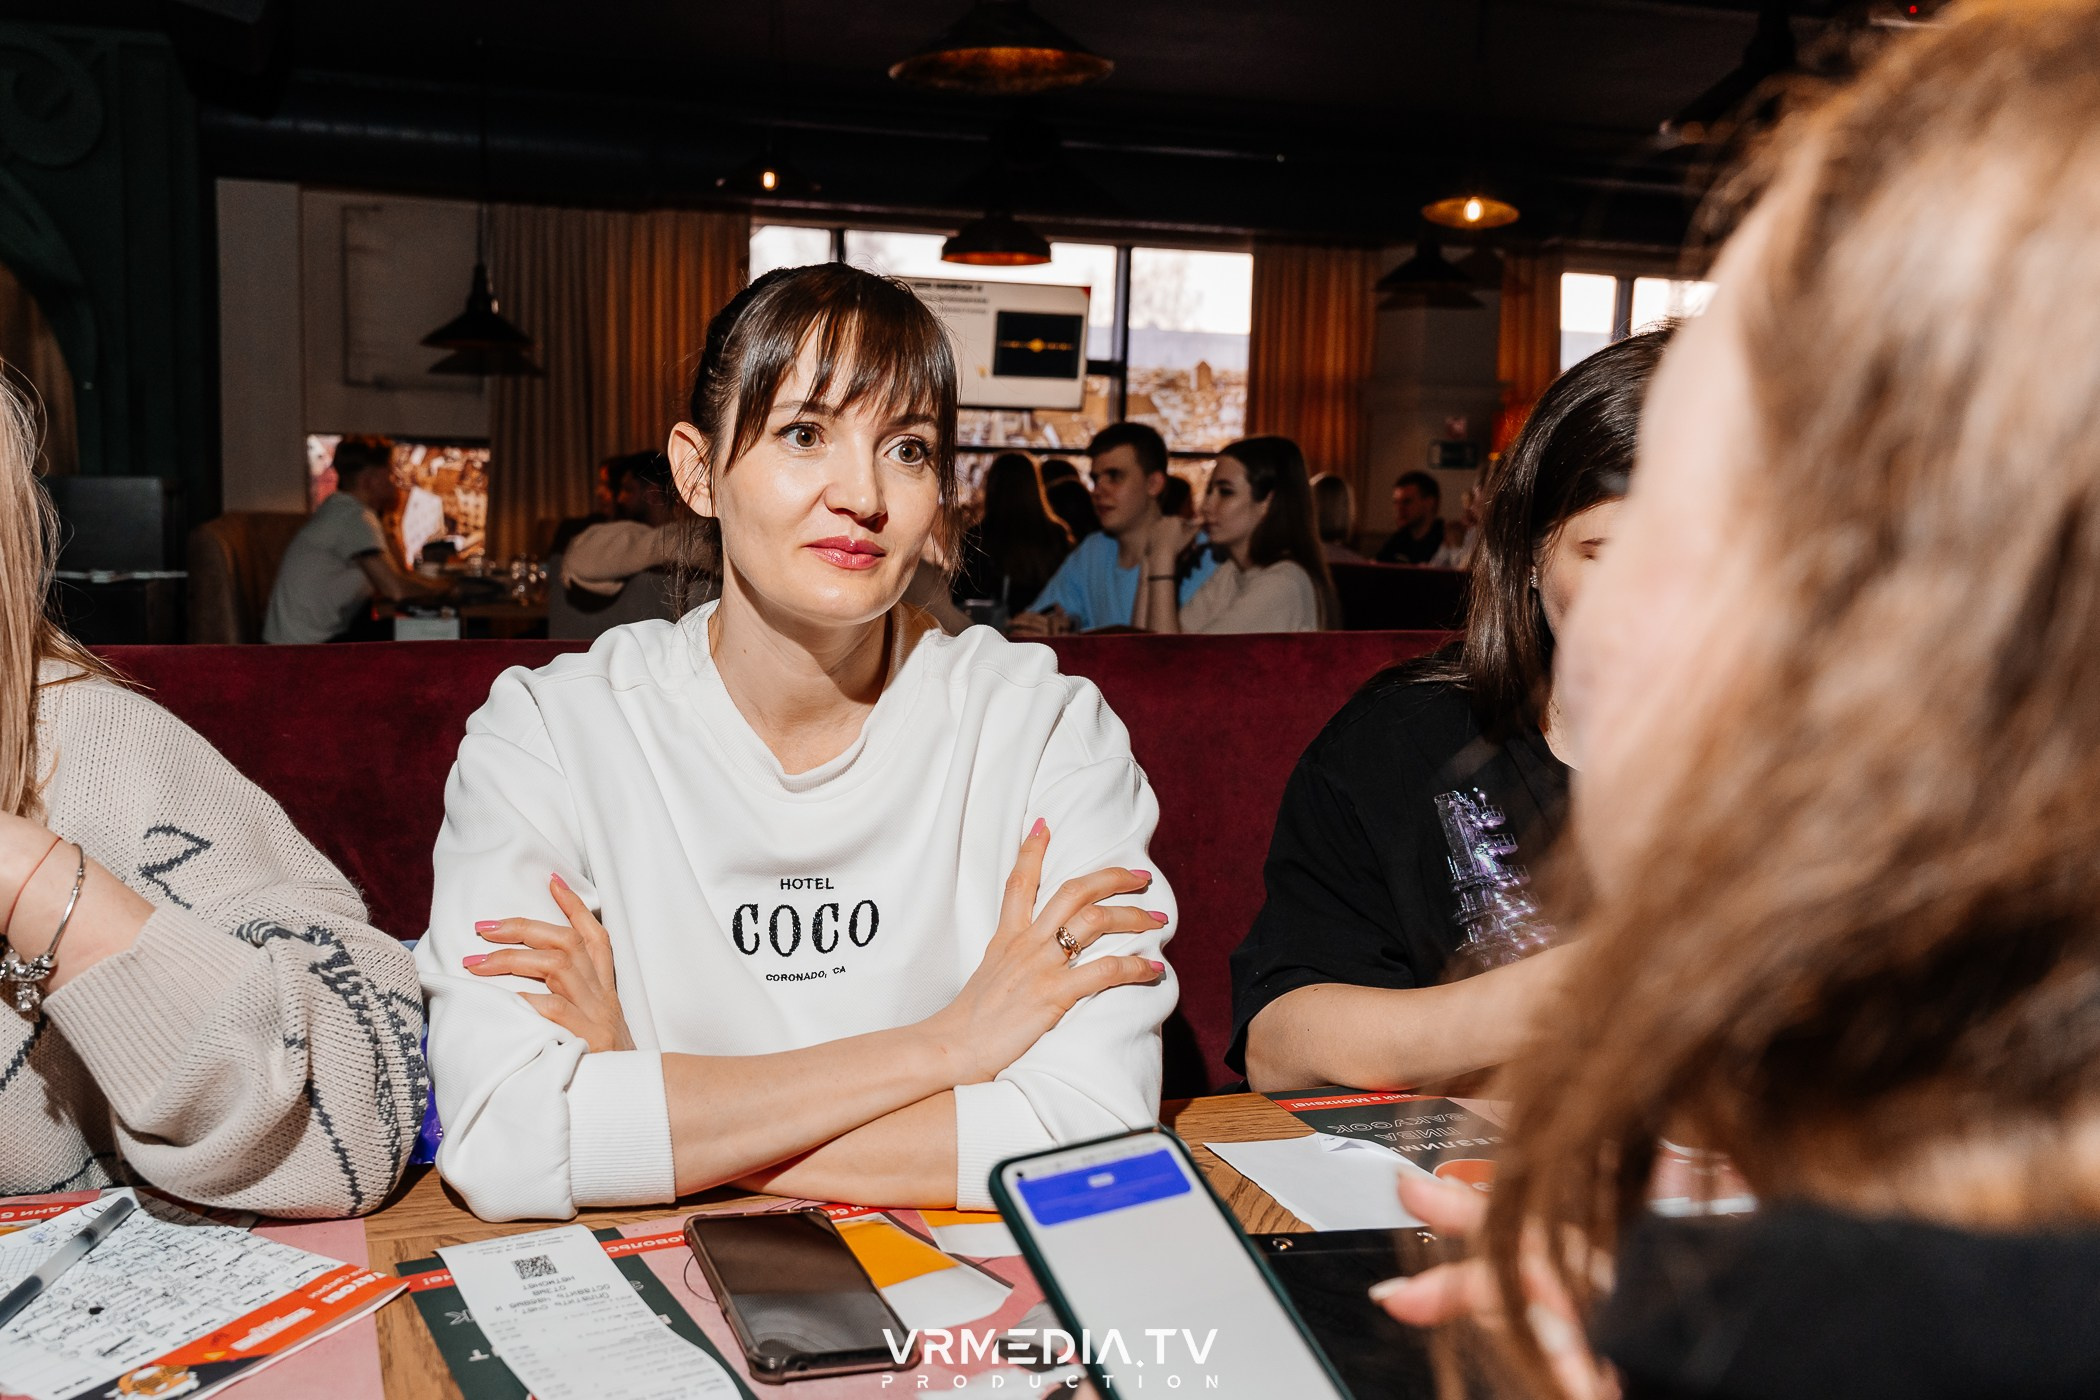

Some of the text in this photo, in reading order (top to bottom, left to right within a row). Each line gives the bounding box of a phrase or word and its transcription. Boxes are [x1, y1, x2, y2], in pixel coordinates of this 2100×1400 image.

[780, 877, 834, 890] HOTEL
[732, 899, 880, 957] COCO
[766, 965, 846, 982] CORONADO, CA
[1291, 1095, 1371, 1108] Мюнхене!
[1326, 1112, 1468, 1134] ЗАКУСОК
[1374, 1125, 1462, 1142] ПИВА
